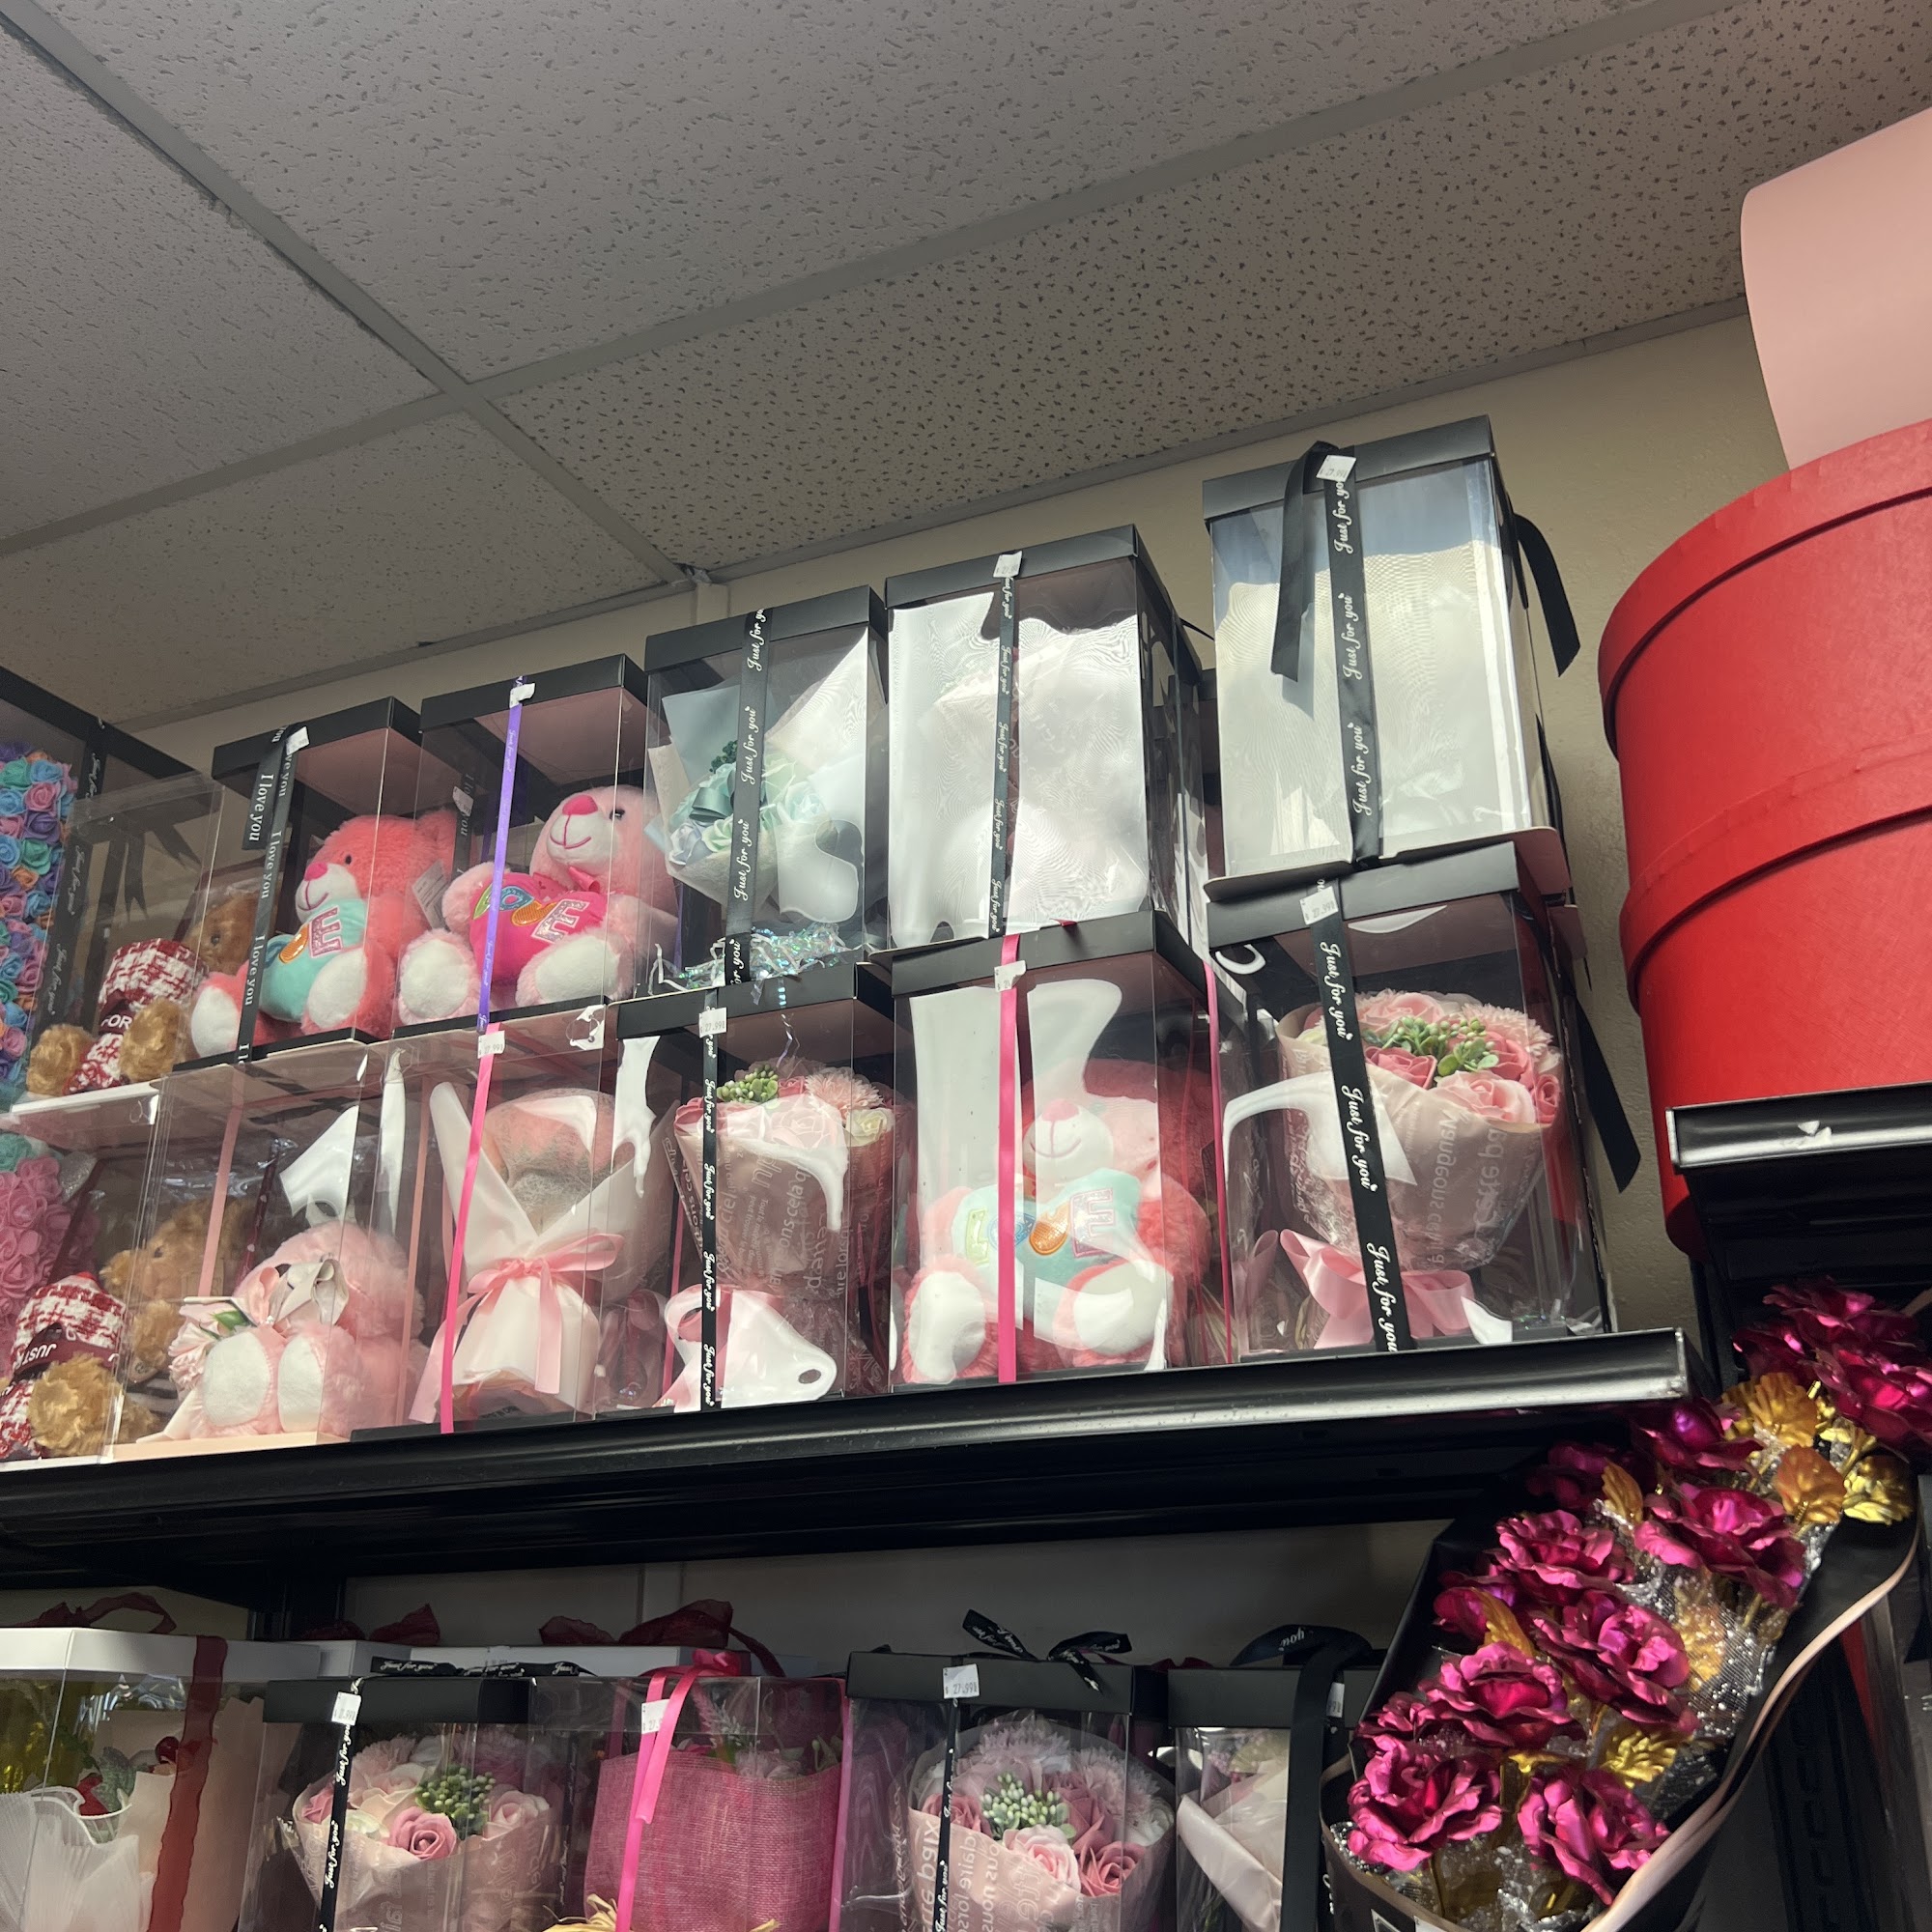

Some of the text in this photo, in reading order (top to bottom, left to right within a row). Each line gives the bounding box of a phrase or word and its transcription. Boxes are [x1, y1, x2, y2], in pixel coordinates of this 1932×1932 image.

[1332, 482, 1353, 554] Just for yo
[747, 609, 766, 671] Just for yo
[1341, 595, 1363, 680] Just for you
[1001, 645, 1011, 665] Just
[1001, 663, 1010, 677] for
[741, 708, 759, 785] Just for you
[996, 722, 1009, 771] Just for you
[1350, 725, 1373, 816] Just for you
[254, 781, 272, 812] love
[995, 798, 1005, 818] Just
[249, 813, 264, 841] you
[994, 815, 1004, 831] for
[266, 839, 280, 872] love
[734, 821, 753, 900] Just for you
[261, 872, 272, 899] you
[992, 879, 1002, 898] Just
[991, 896, 1000, 912] for
[249, 943, 264, 976] love
[732, 941, 745, 969] you
[244, 978, 256, 1006] you
[1320, 942, 1347, 1038] Just for you
[705, 1078, 715, 1099] Just
[704, 1095, 715, 1114] for
[1341, 1085, 1371, 1189] Just for you
[704, 1163, 715, 1185] Just
[704, 1181, 714, 1201] for
[703, 1251, 715, 1273] Just
[703, 1270, 714, 1290] for
[1366, 1242, 1399, 1351] Just for you
[21, 1343, 57, 1366] JUST
[703, 1344, 715, 1368] Just
[703, 1363, 715, 1384] for
[381, 1662, 402, 1671] Just
[399, 1662, 416, 1671] for
[339, 1743, 349, 1765] for
[336, 1760, 347, 1786] Just
[327, 1844, 338, 1866] for
[325, 1862, 335, 1889] Just
[937, 1887, 948, 1913] for
[935, 1907, 948, 1932] Just
